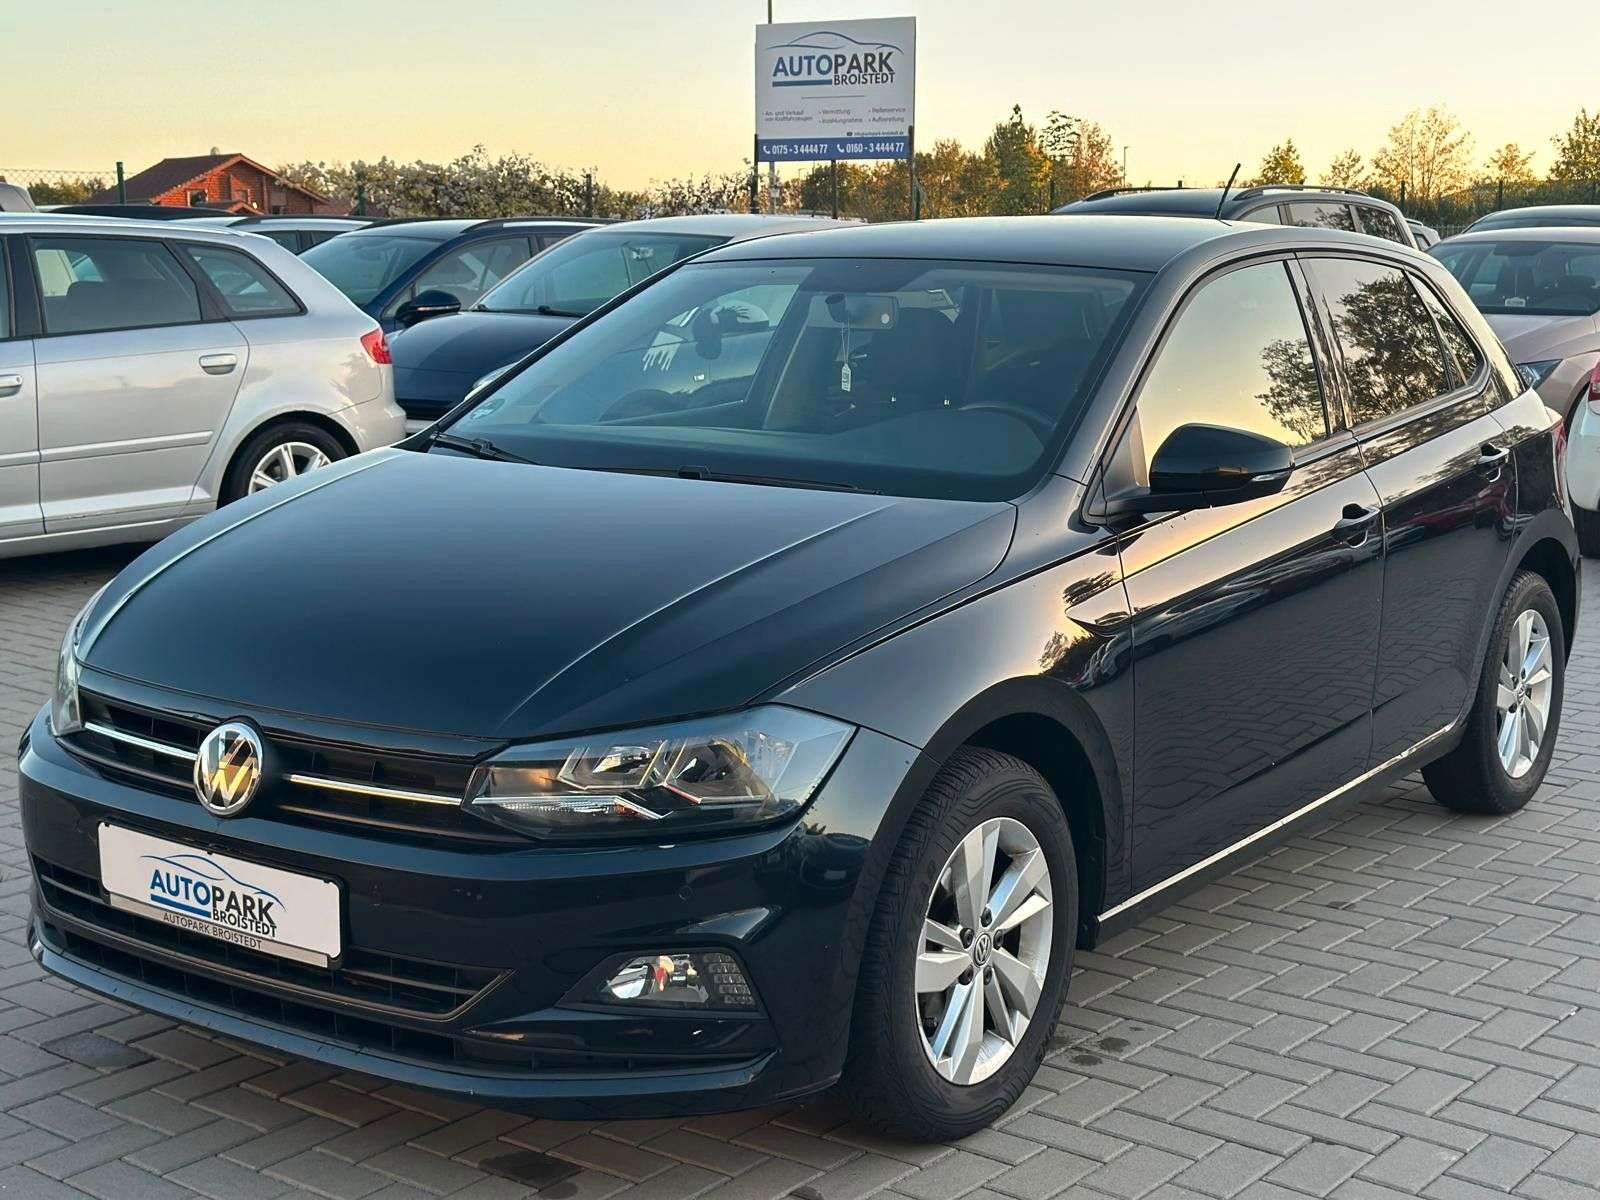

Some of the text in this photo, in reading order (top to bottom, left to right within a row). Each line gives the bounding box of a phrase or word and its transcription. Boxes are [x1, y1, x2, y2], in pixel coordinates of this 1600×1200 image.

[772, 51, 895, 77] AUTOPARK
[833, 72, 896, 86] BROISTEDT
[771, 144, 788, 155] 0175
[846, 143, 864, 154] 0160
[150, 869, 276, 925] AUTOPARK
[163, 912, 262, 950] AUTOPARK BROISTEDT
[212, 909, 277, 938] BROISTEDT
